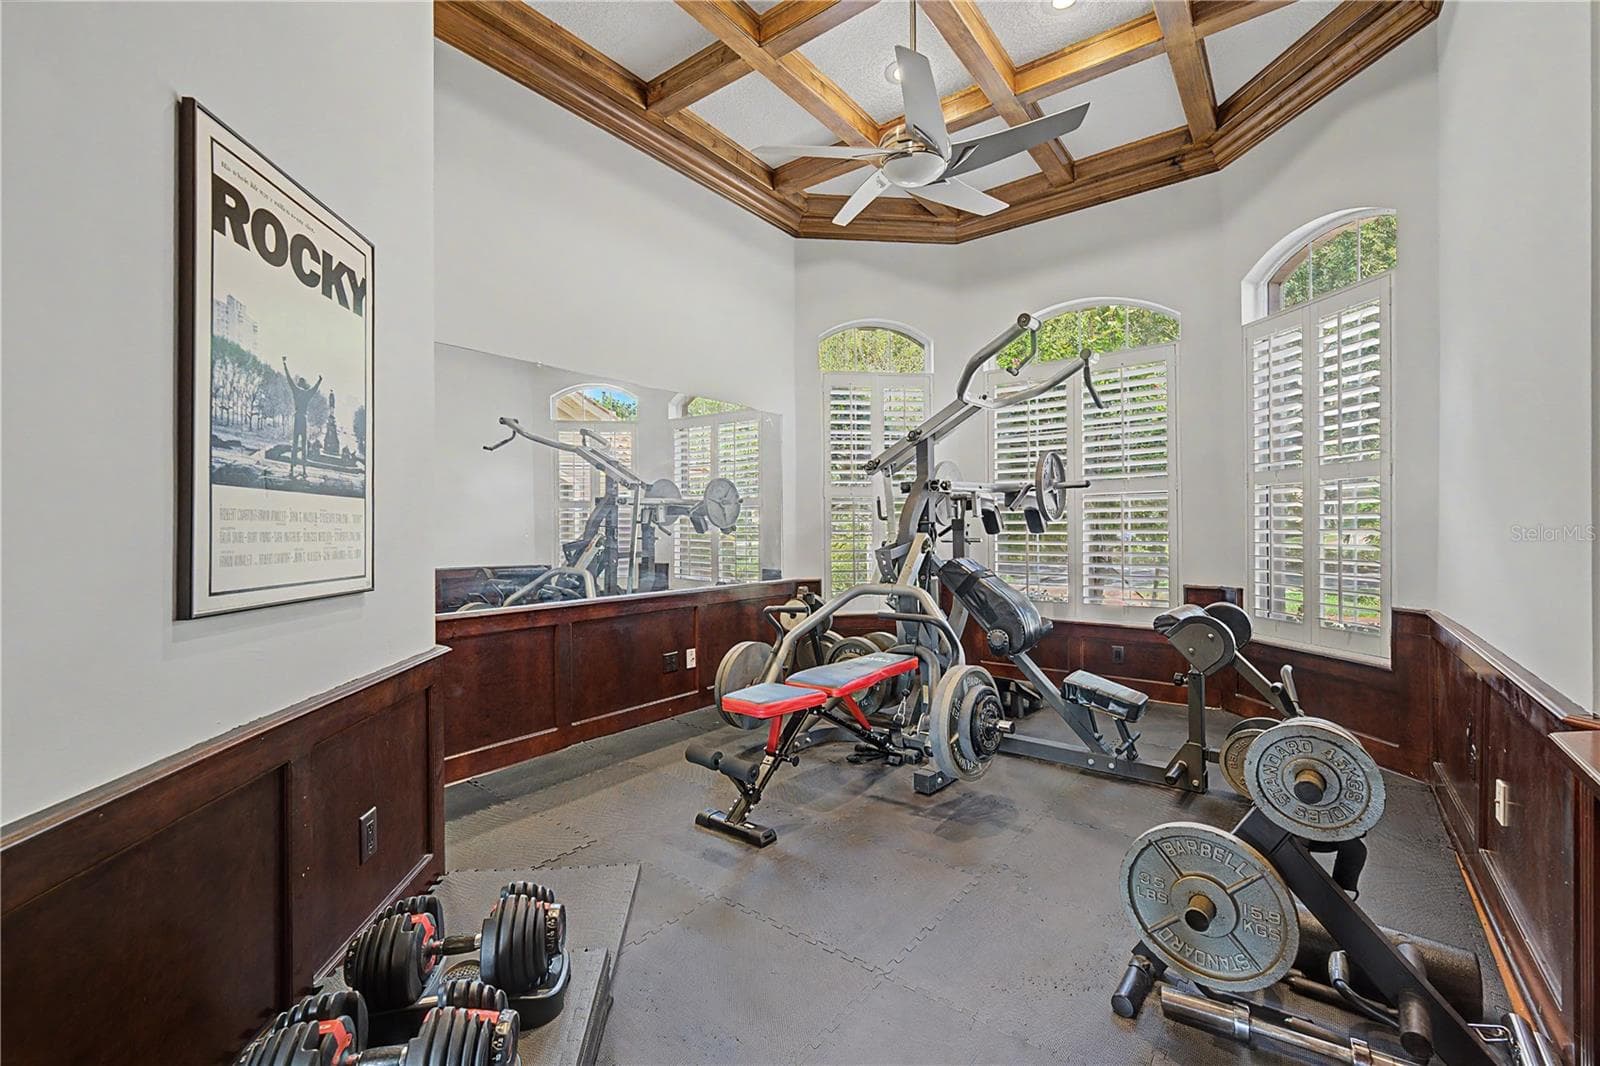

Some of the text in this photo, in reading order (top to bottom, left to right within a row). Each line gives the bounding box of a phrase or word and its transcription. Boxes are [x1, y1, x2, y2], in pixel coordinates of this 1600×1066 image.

[212, 173, 366, 317] ROCKY
[1263, 739, 1314, 807] STANDARD
[1162, 839, 1250, 879] BARBELL
[1136, 886, 1169, 905] LBS
[1157, 927, 1252, 972] STANDARD
[1242, 919, 1282, 942] KGS
